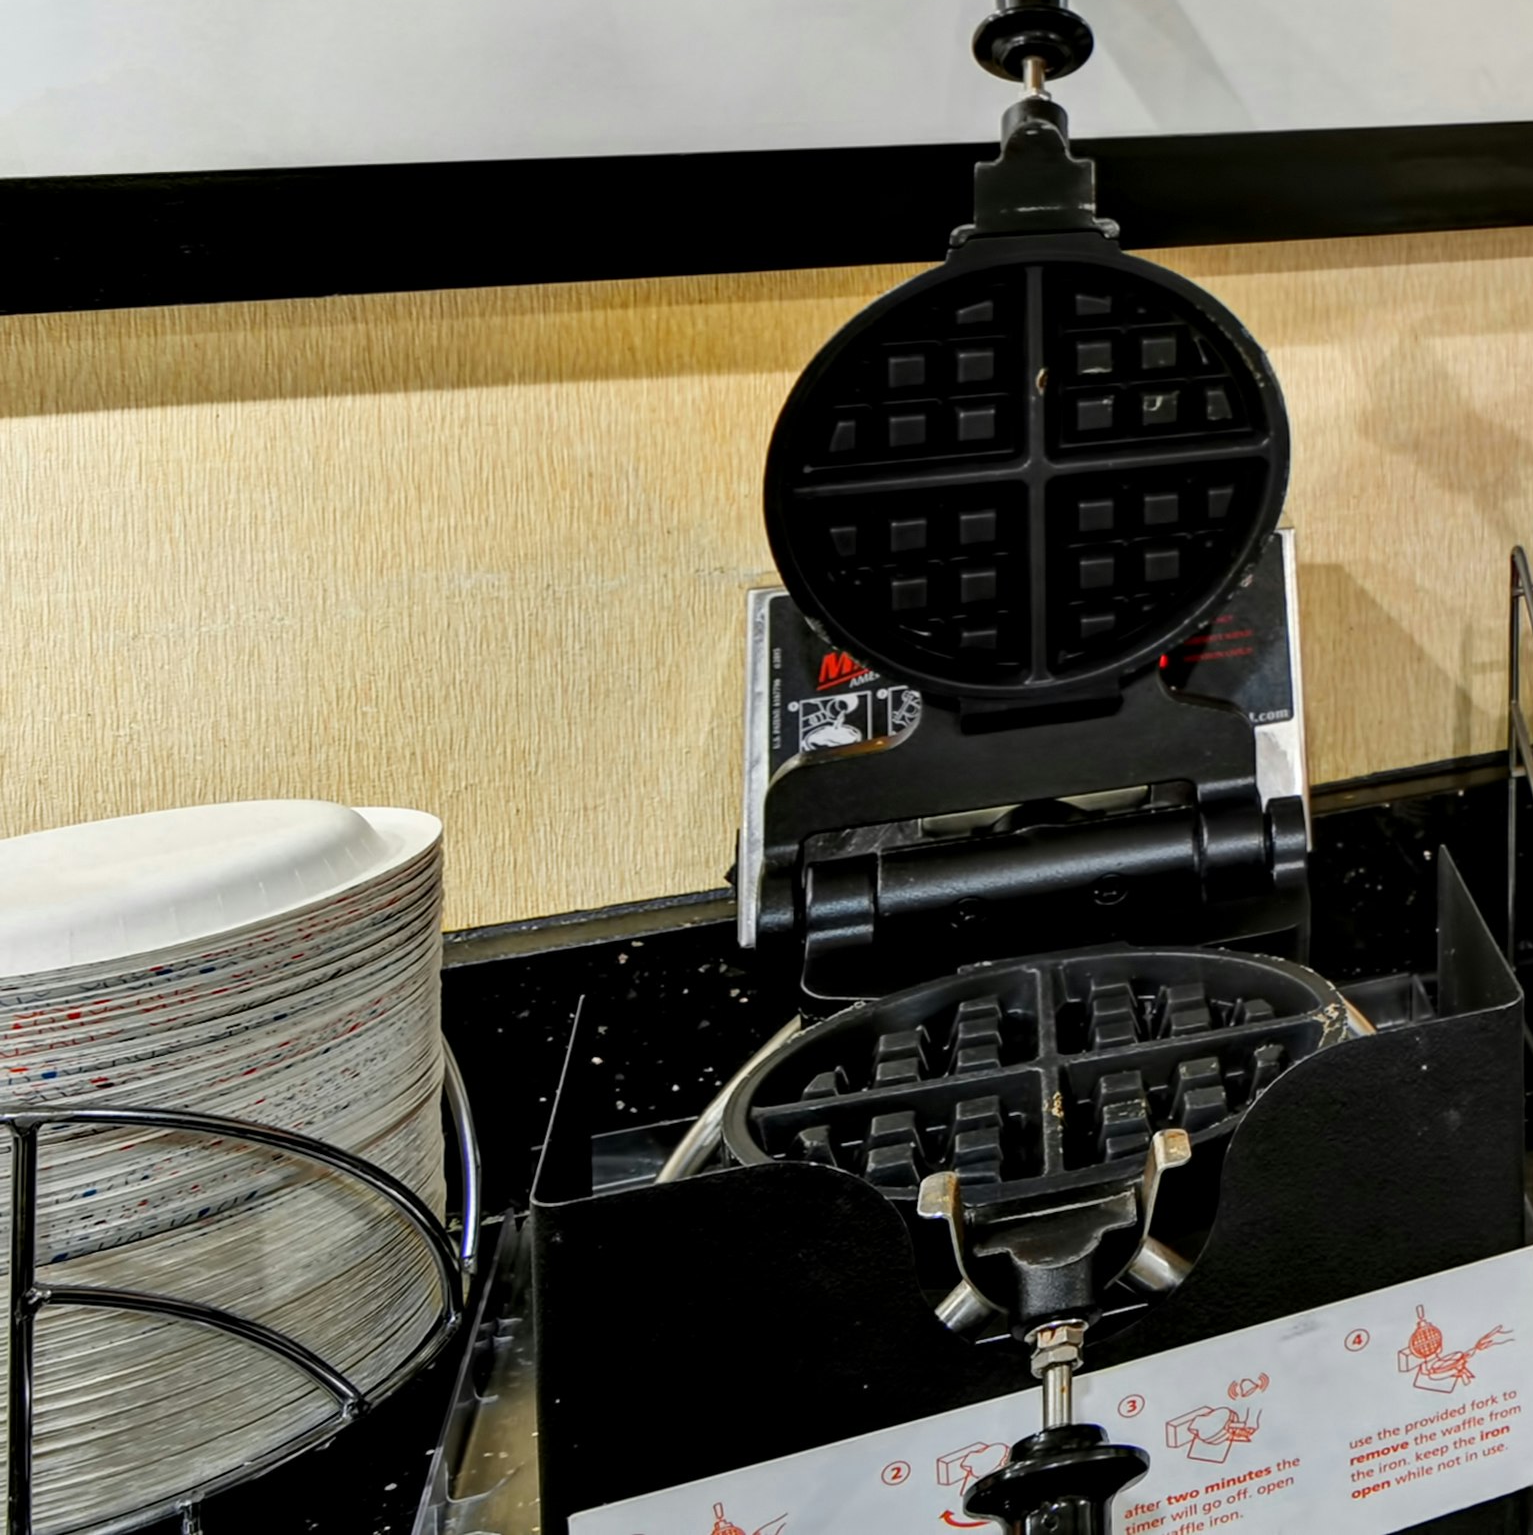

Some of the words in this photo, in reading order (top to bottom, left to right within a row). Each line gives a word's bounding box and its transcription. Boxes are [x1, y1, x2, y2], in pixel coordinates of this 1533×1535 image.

[1349, 1434, 1373, 1450] use
[1377, 1426, 1401, 1442] the
[1405, 1403, 1466, 1435] provided
[1470, 1395, 1499, 1412] fork
[1502, 1390, 1517, 1402] to
[1349, 1441, 1410, 1466] remove
[1413, 1431, 1438, 1446] the
[1440, 1416, 1485, 1438] waffle
[1488, 1404, 1522, 1423] from
[1350, 1467, 1375, 1483] the
[1378, 1457, 1411, 1474] iron.
[1415, 1444, 1449, 1463] keep
[1452, 1435, 1476, 1451] the
[1479, 1424, 1511, 1442] iron
[1351, 1478, 1392, 1500] open
[1395, 1463, 1434, 1486] while
[1437, 1456, 1462, 1472] not
[1465, 1451, 1478, 1463] in
[1482, 1443, 1509, 1458] use.
[1124, 1499, 1162, 1520] after
[1166, 1487, 1200, 1507] two
[1204, 1464, 1273, 1496] minutes
[1276, 1456, 1301, 1473] the
[1125, 1514, 1166, 1535] timer
[1170, 1502, 1199, 1523] will
[1202, 1499, 1222, 1516] go
[1226, 1487, 1253, 1506] off.
[1256, 1475, 1296, 1499] open
[1209, 1509, 1245, 1529] iron.
